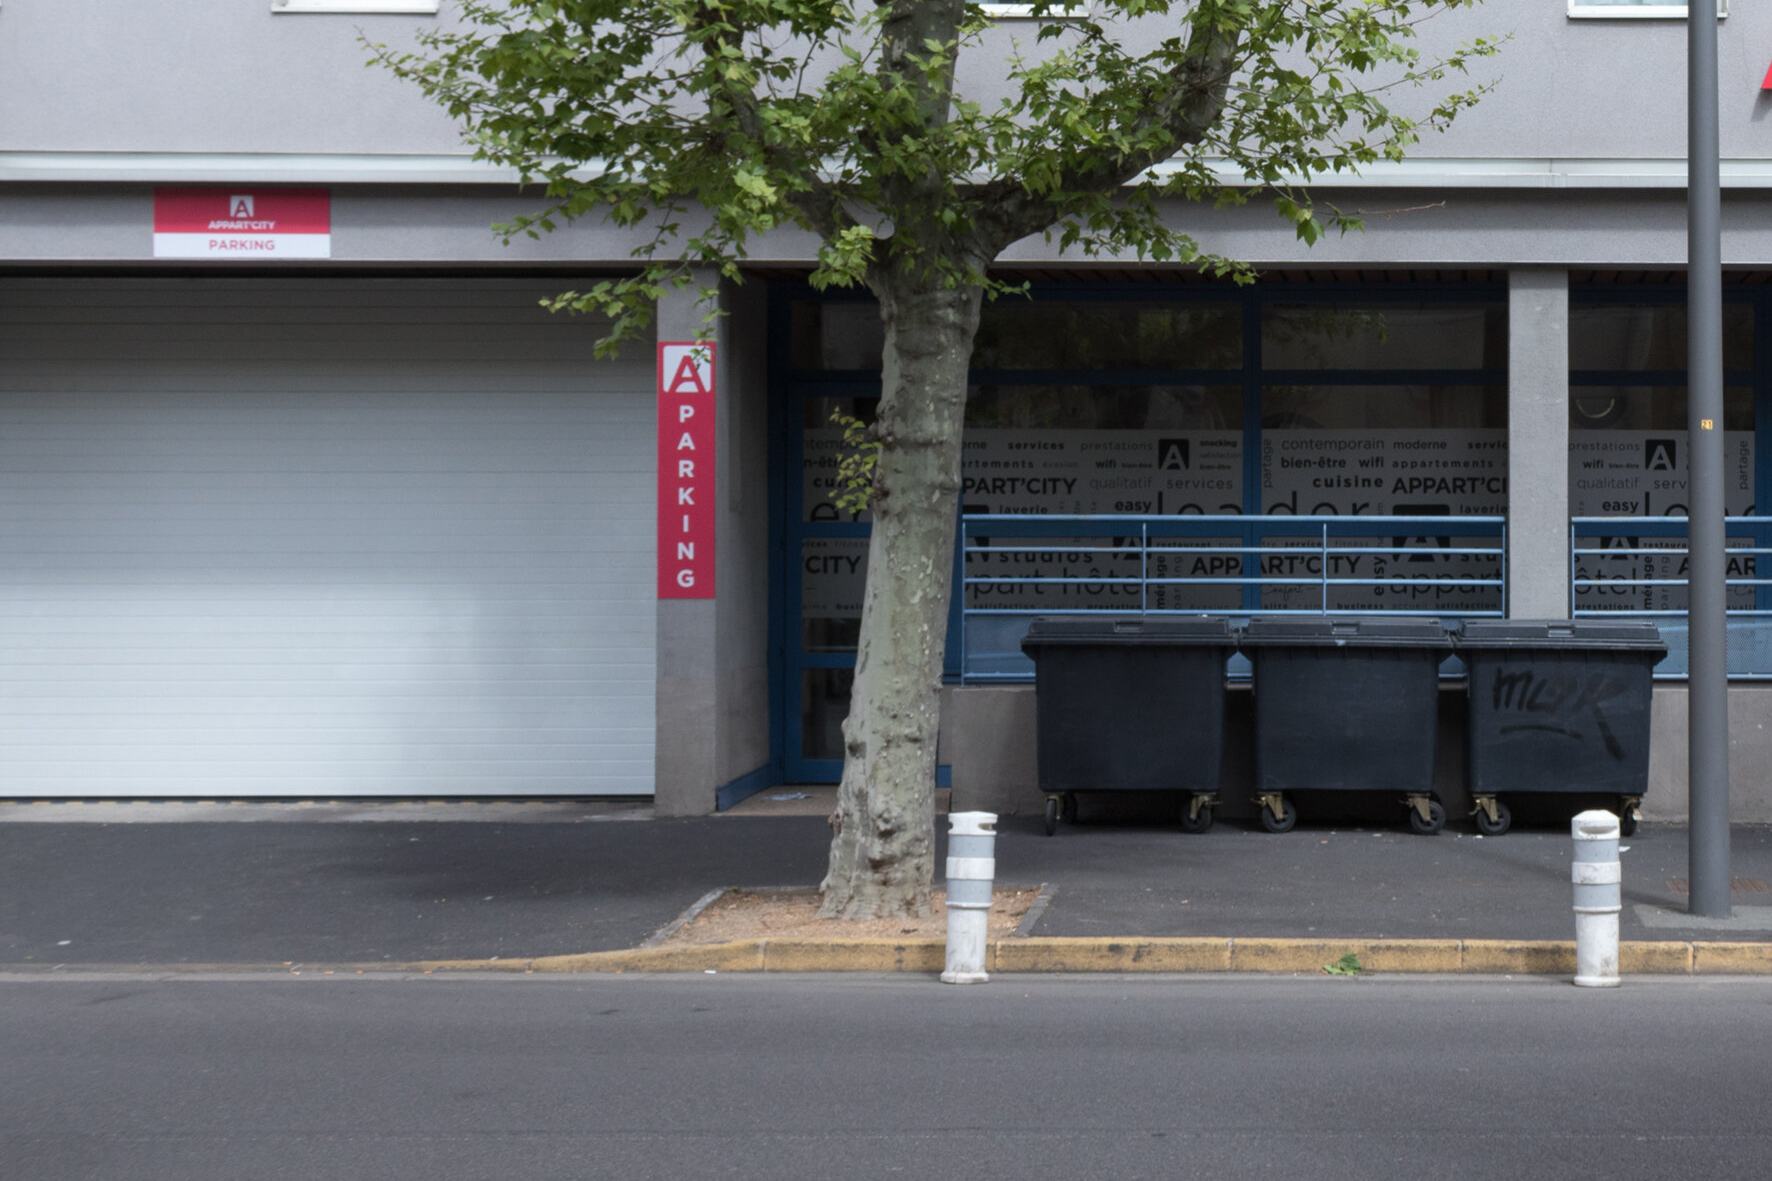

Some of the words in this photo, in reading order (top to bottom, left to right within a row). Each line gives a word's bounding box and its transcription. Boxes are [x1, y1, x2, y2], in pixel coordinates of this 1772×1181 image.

[208, 220, 275, 230] APPART'CITY
[209, 239, 275, 251] PARKING
[1702, 420, 1712, 429] 21
[962, 441, 987, 450] erne
[1008, 441, 1064, 451] services
[1081, 441, 1153, 452] prestations
[1281, 438, 1385, 452] contemporain
[1393, 440, 1447, 450] moderne
[1468, 441, 1508, 450] servi
[962, 460, 1034, 469] rtements
[1095, 459, 1117, 469] wifi
[1263, 438, 1274, 488] partage
[1280, 457, 1346, 468] bien-être
[1359, 457, 1384, 468] wifi
[1392, 460, 1494, 470] appartements
[1582, 459, 1604, 469] wifi
[1739, 440, 1750, 490] partage
[962, 477, 1077, 495] PART'CITY
[1089, 478, 1153, 490] qualitatif
[1166, 478, 1233, 489] services
[1312, 475, 1384, 488] cuisine
[1392, 477, 1507, 494] APPART'CI
[1577, 478, 1639, 490] qualitatif
[1654, 480, 1687, 489] serv
[676, 405, 696, 588] PARKING
[999, 505, 1048, 514] laverie
[1115, 500, 1152, 513] easy
[1602, 500, 1639, 513] easy
[1191, 556, 1361, 575] APPRT'CTY
[1155, 556, 1167, 609] méage
[1174, 556, 1183, 609] paring
[1575, 567, 1637, 595] ôtel
[1643, 556, 1655, 609] méage
[1661, 556, 1670, 610] paring
